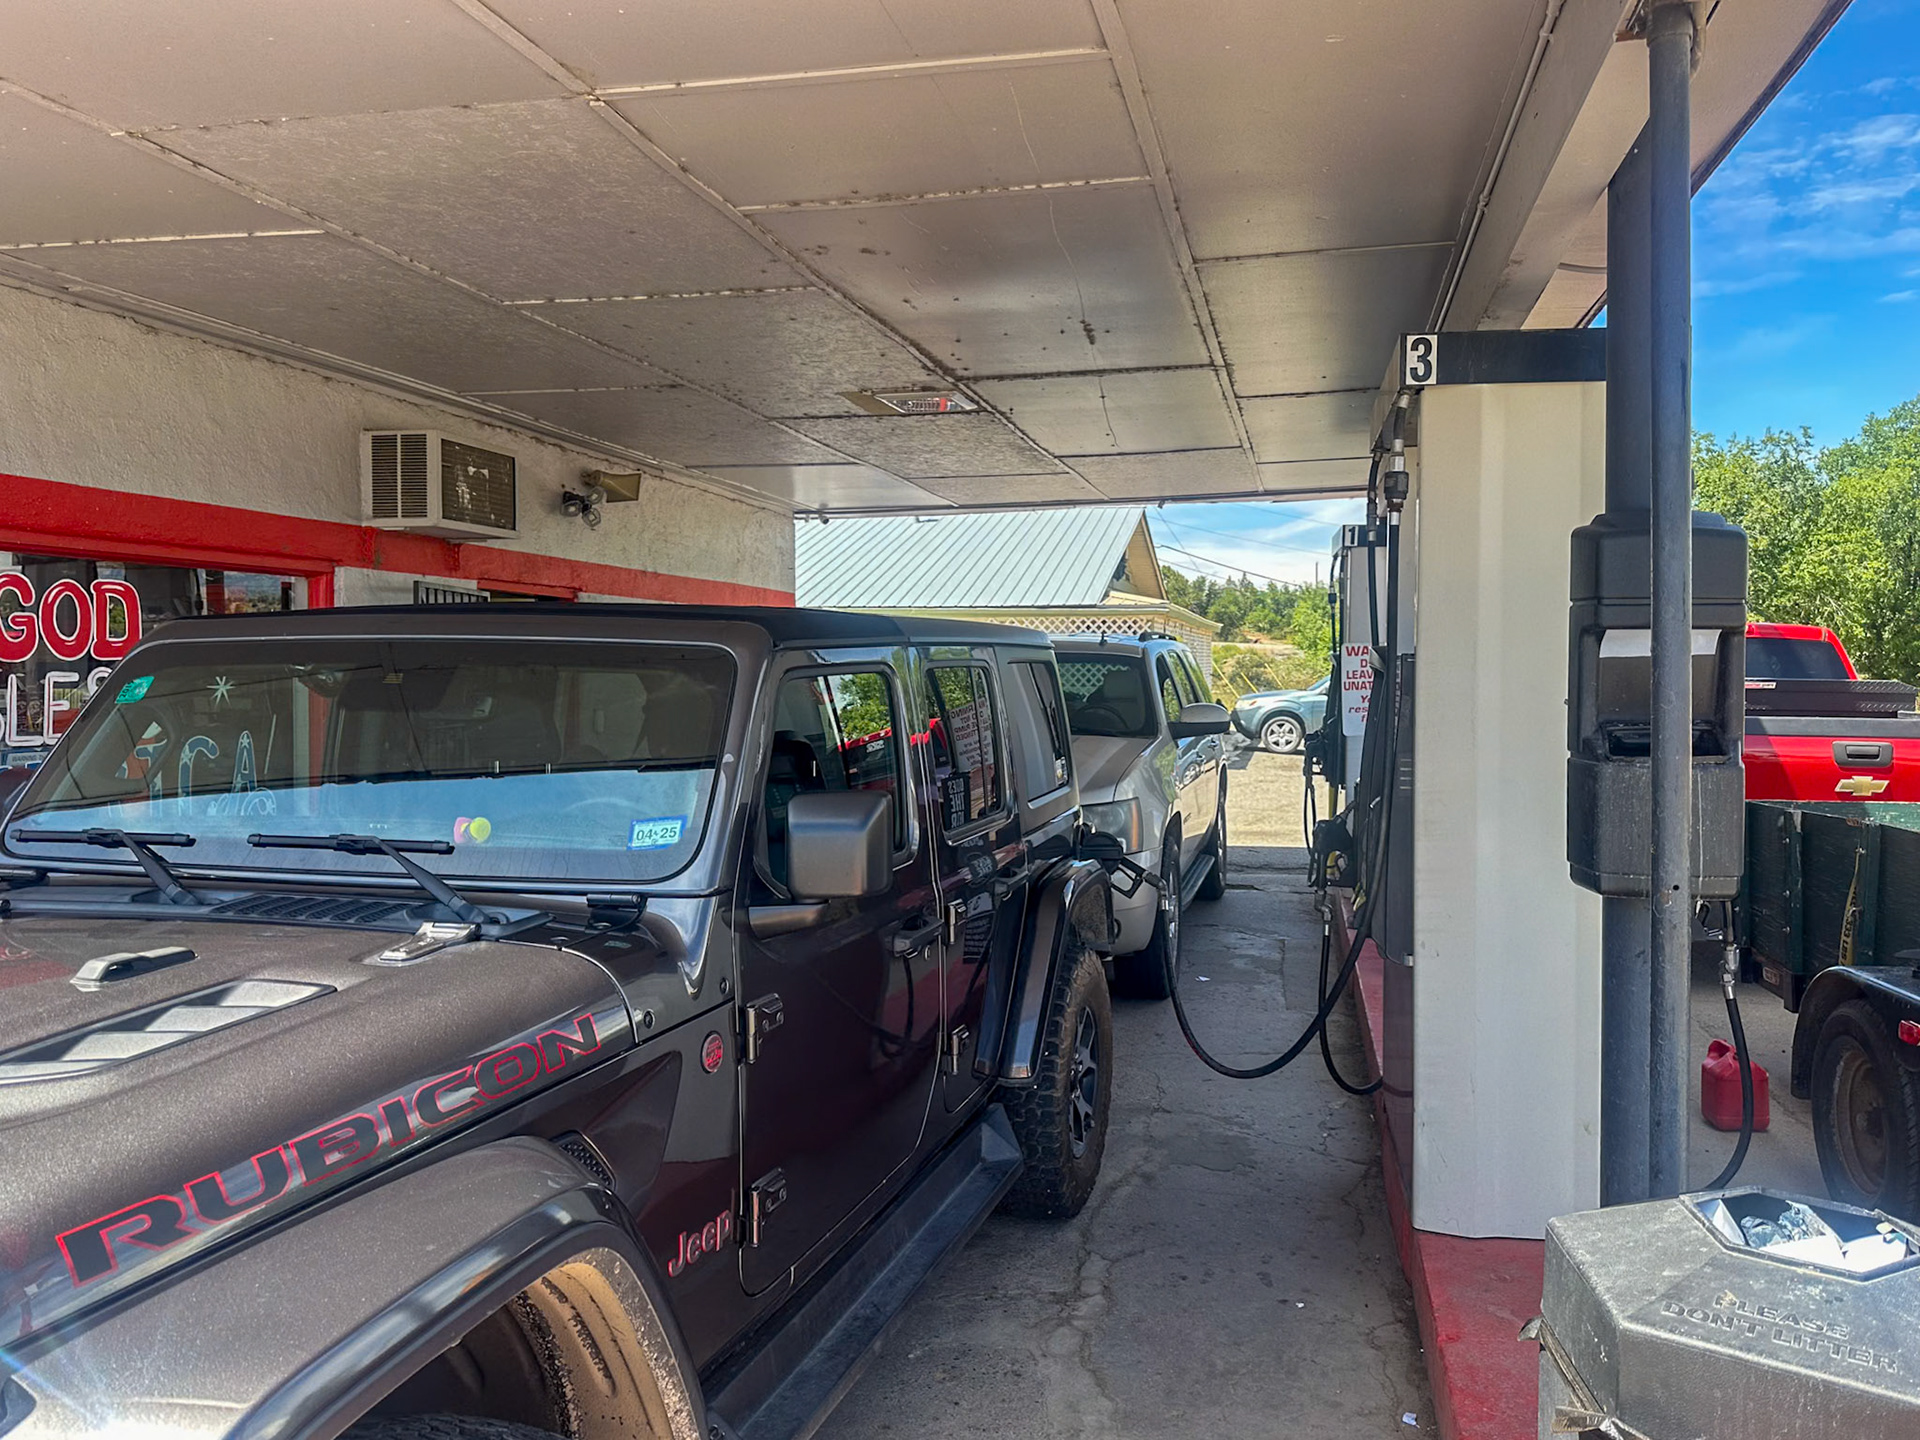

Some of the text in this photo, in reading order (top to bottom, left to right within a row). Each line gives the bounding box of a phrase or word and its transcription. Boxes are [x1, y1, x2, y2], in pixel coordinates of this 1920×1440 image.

[1410, 337, 1432, 382] 3
[1349, 526, 1356, 545] 1
[0, 571, 142, 662] GOD
[1345, 646, 1370, 656] WA
[1361, 659, 1369, 668] D
[1343, 681, 1374, 691] UNAT
[1346, 670, 1374, 679] LEAV
[0, 667, 113, 747] LE
[636, 827, 677, 841] 04 25
[55, 1013, 600, 1288] RUBICON
[668, 1210, 732, 1277] Jeep
[1661, 1301, 1897, 1373] DON'T LITTER
[1713, 1294, 1849, 1339] PLEASE
